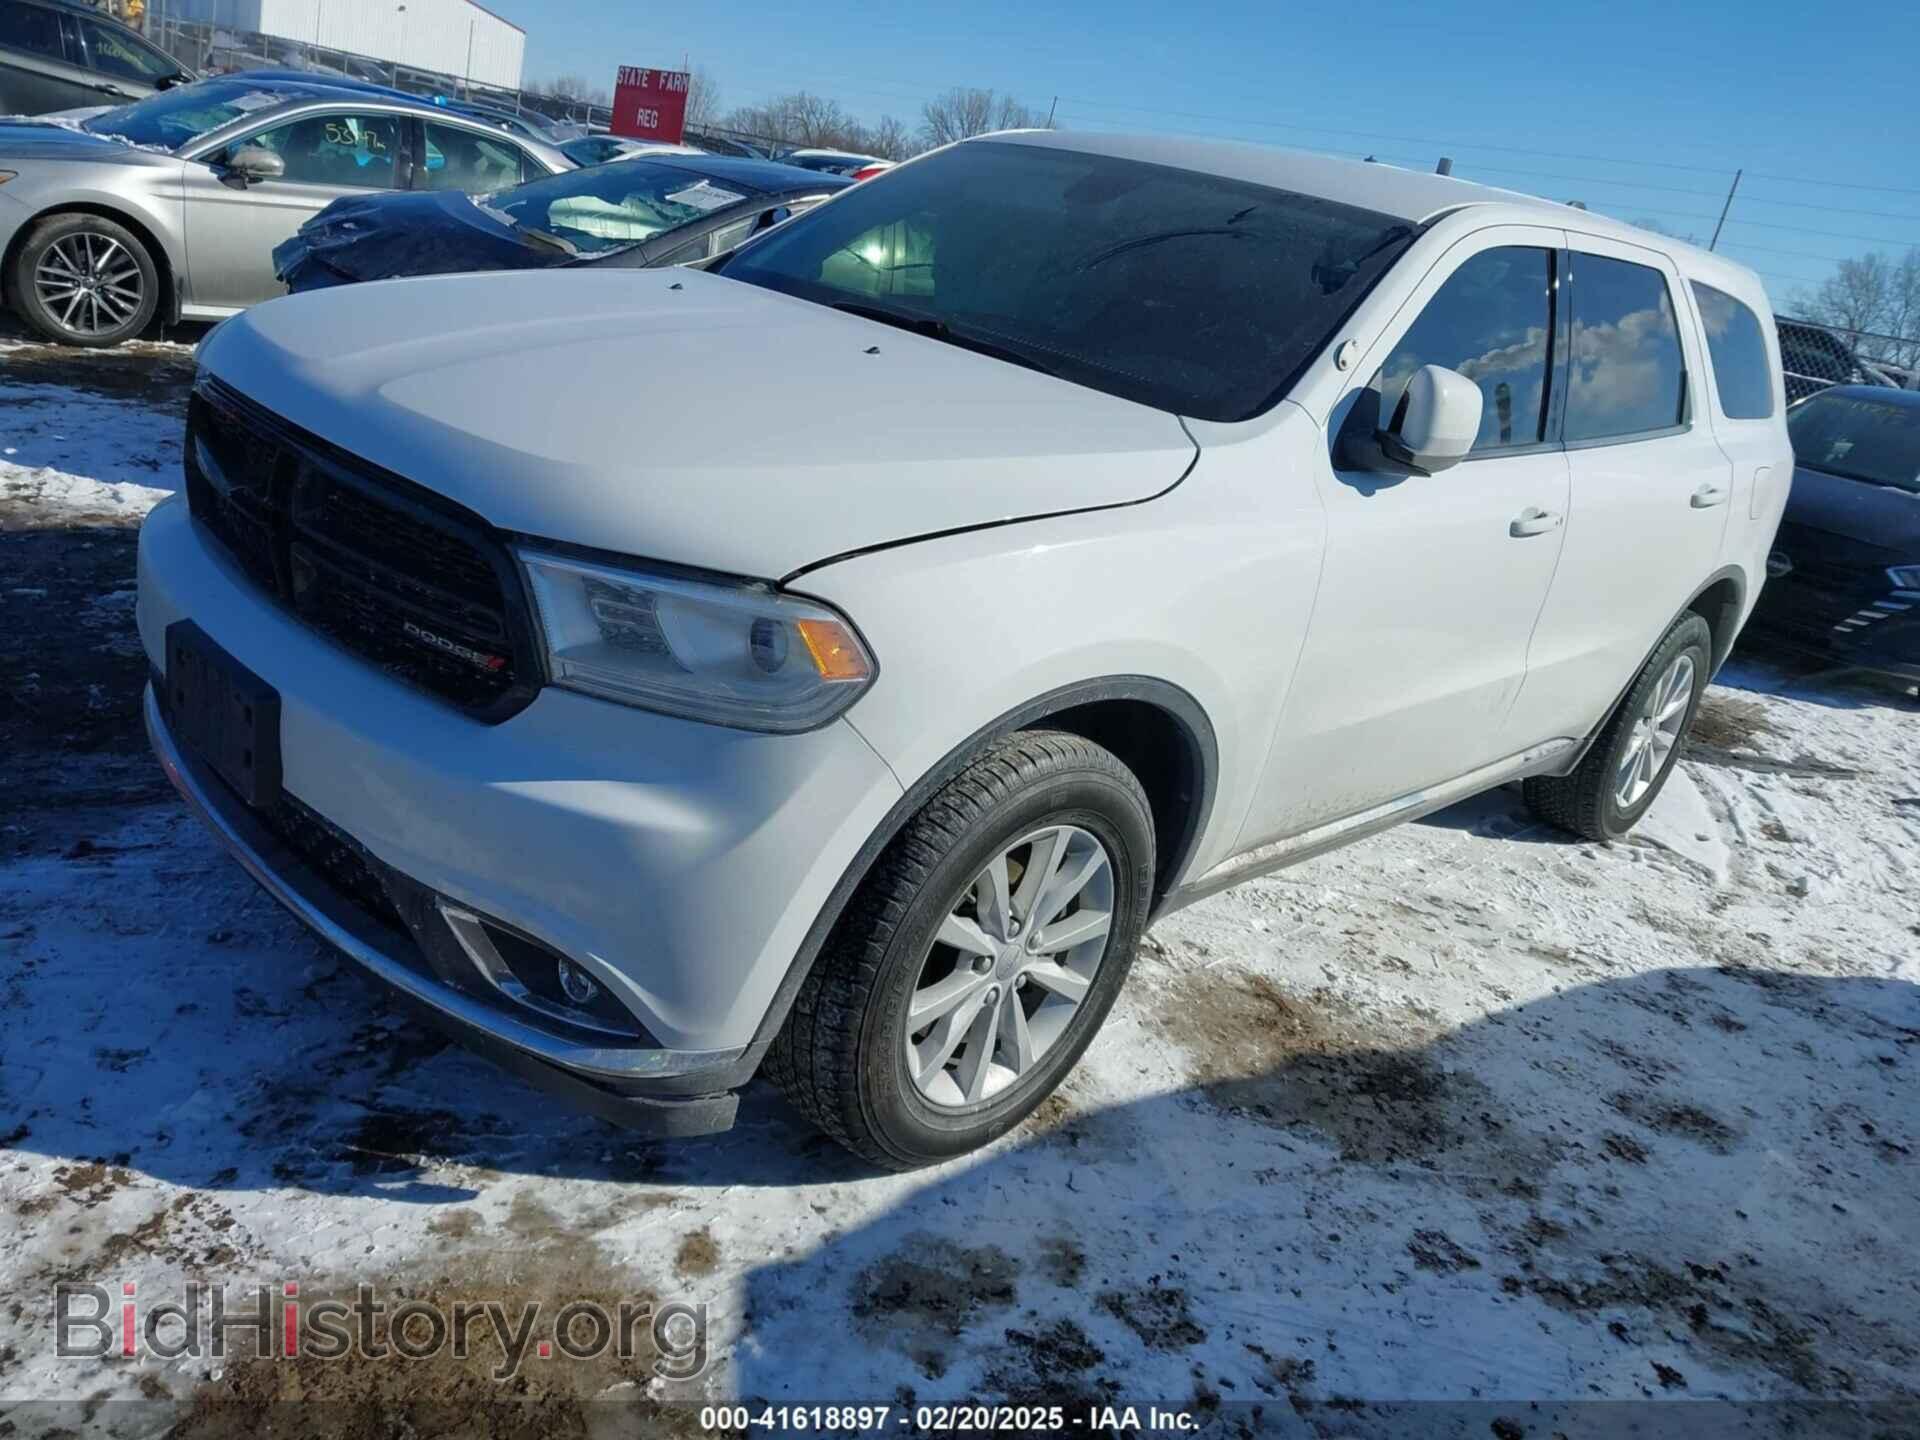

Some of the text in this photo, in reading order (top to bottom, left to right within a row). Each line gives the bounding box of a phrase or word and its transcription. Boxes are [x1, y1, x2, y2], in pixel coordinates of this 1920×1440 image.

[617, 67, 690, 93] STATE FARM
[636, 108, 658, 129] REG
[403, 621, 489, 670] DODGE
